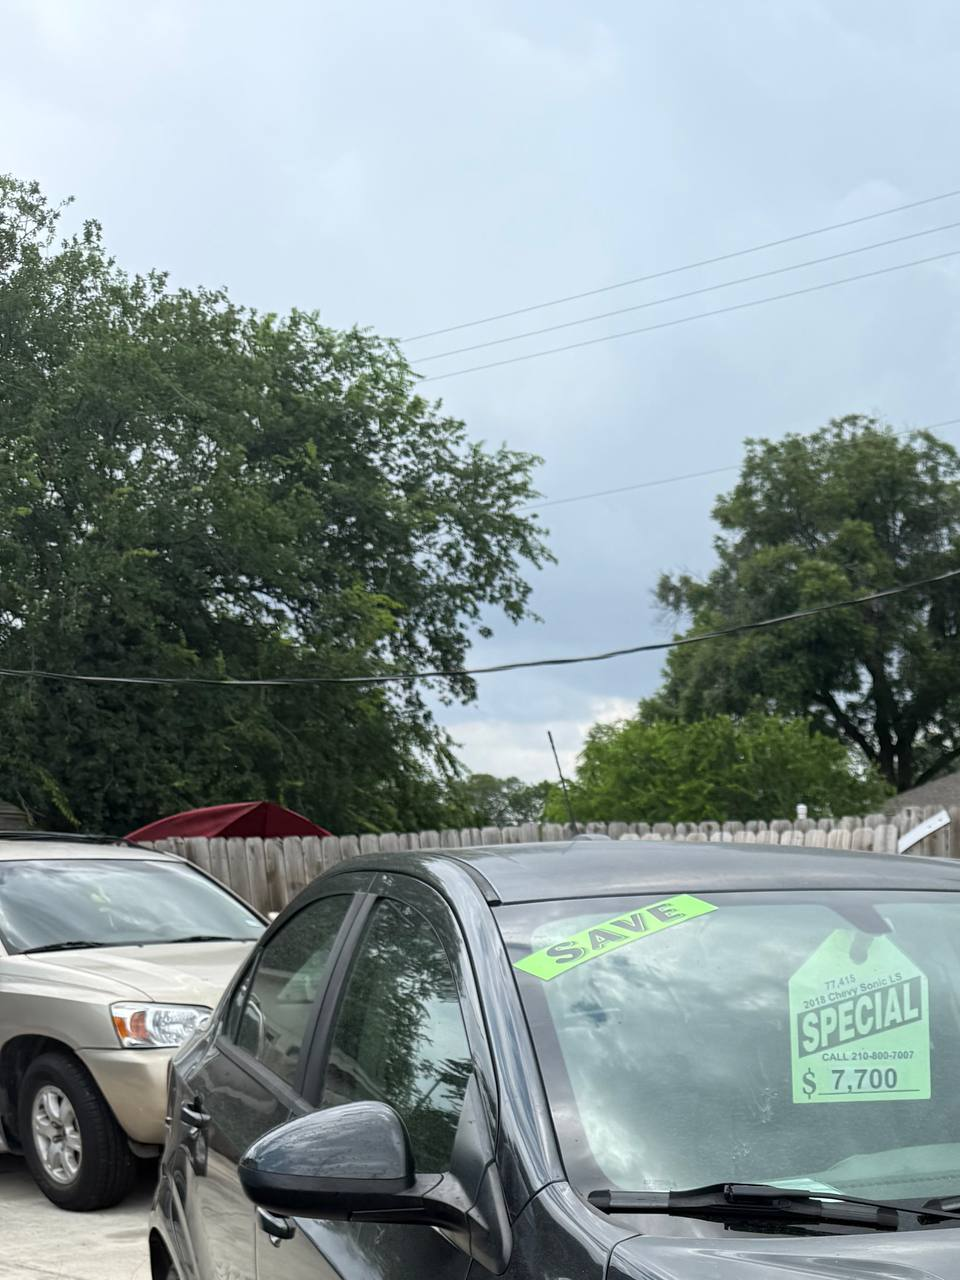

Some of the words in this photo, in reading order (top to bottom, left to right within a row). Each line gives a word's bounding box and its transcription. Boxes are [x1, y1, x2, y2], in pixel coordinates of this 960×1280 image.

[547, 903, 686, 964] SAVE
[803, 995, 826, 1009] 2018
[828, 988, 858, 1002] Chevy
[860, 979, 888, 993] Sonic
[889, 972, 902, 983] LS
[825, 974, 856, 990] 77,415
[802, 982, 918, 1052] SPECIAL
[822, 1052, 848, 1062] CALL
[802, 1067, 816, 1099] $
[831, 1067, 897, 1093] 7,700
